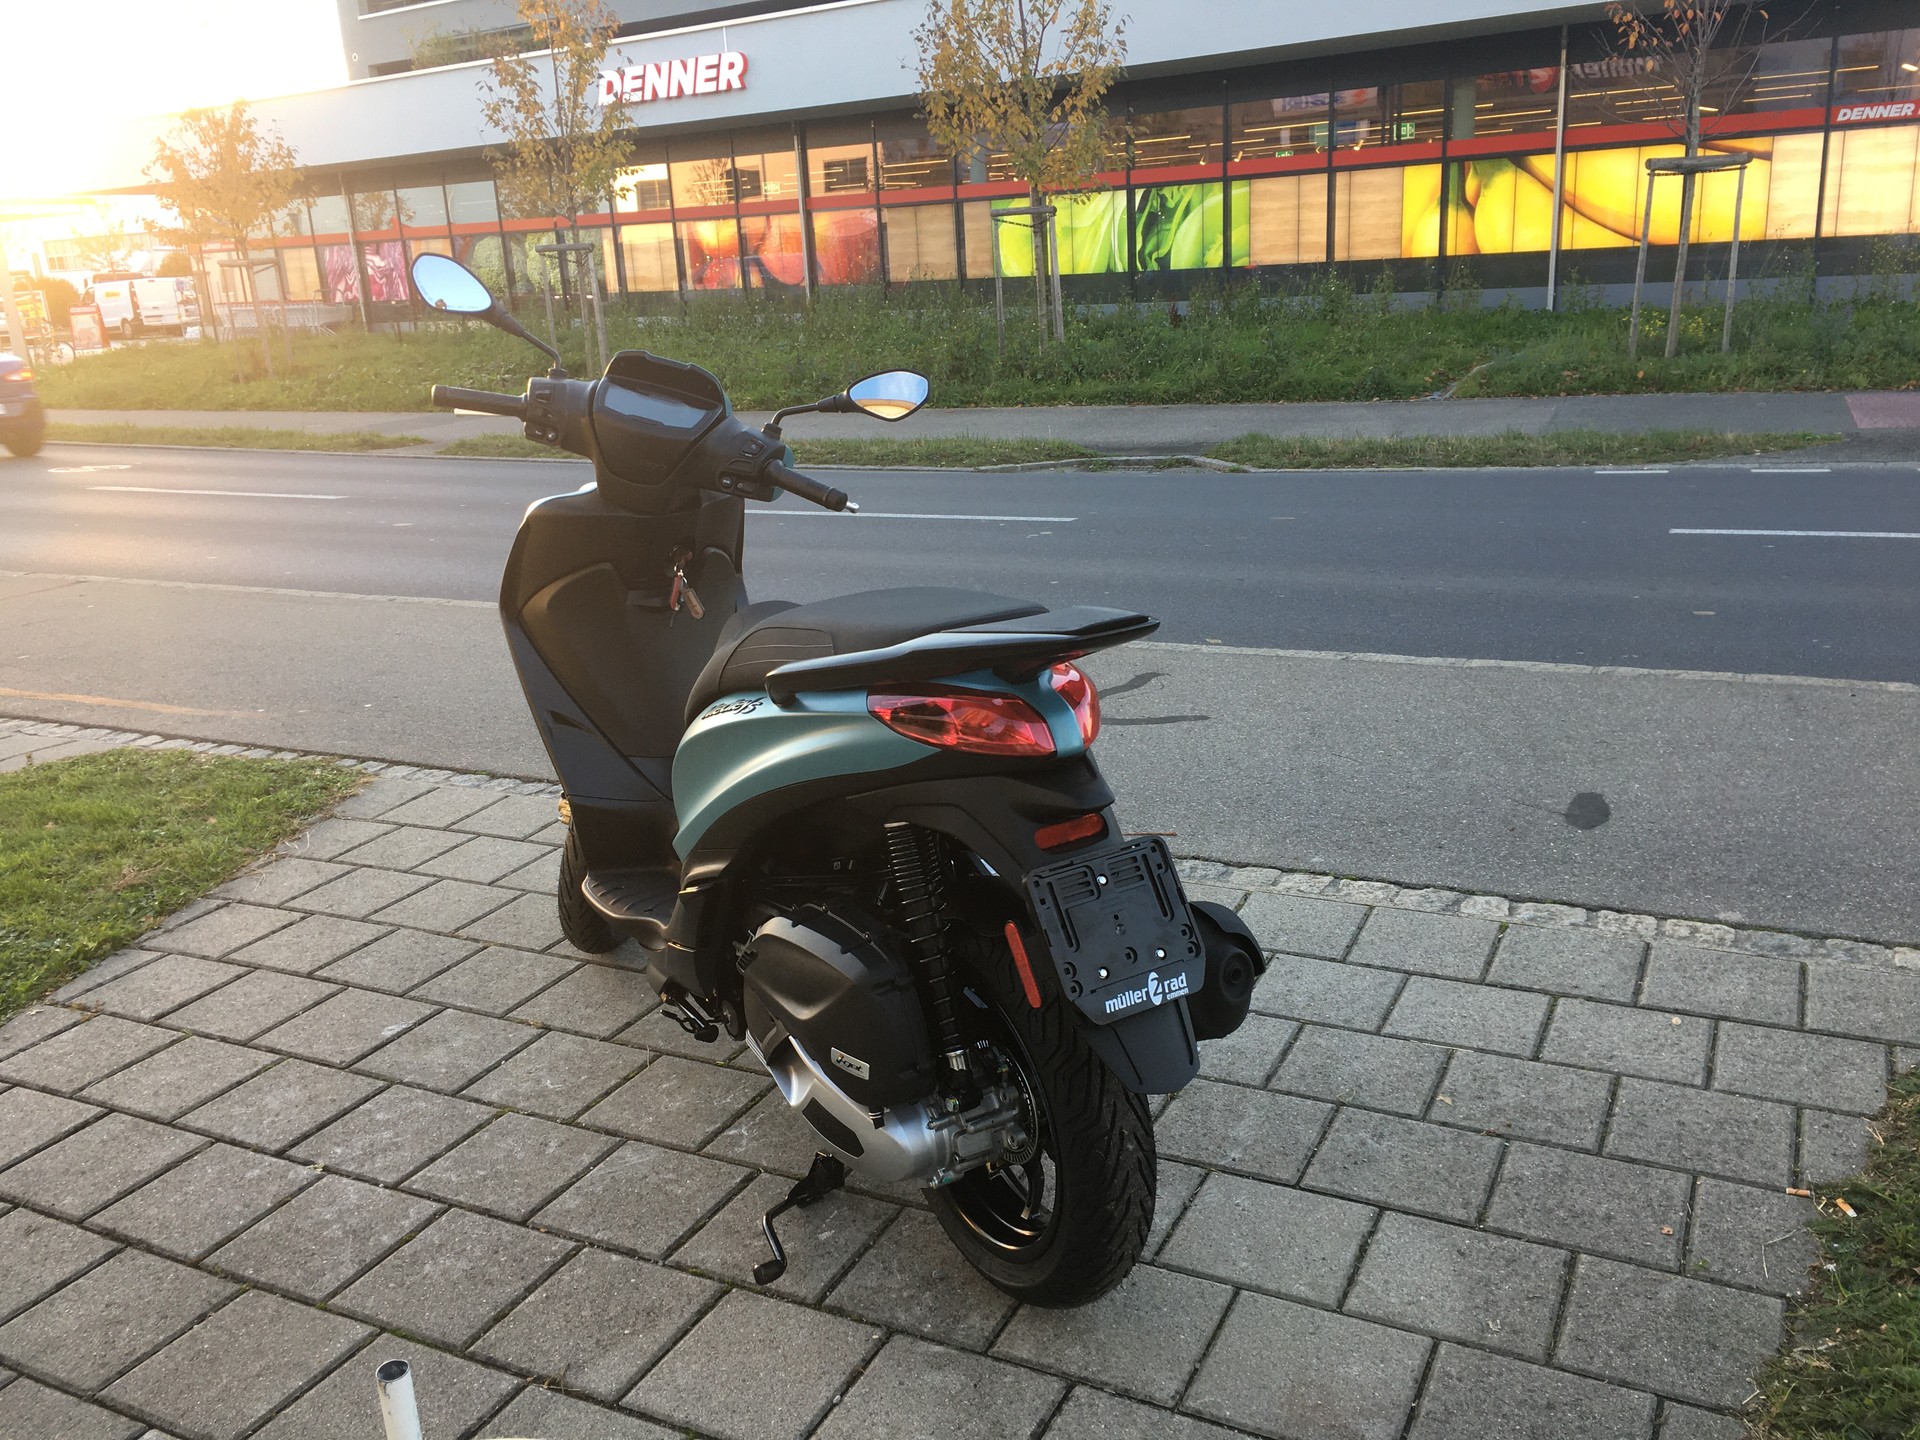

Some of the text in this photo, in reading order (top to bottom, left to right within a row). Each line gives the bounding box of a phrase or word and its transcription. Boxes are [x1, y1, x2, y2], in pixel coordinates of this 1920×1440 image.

[598, 51, 748, 106] DENNER
[1837, 103, 1915, 121] DENNER
[1105, 987, 1148, 1014] müller
[1164, 972, 1188, 993] rad
[1166, 987, 1190, 1000] emmen
